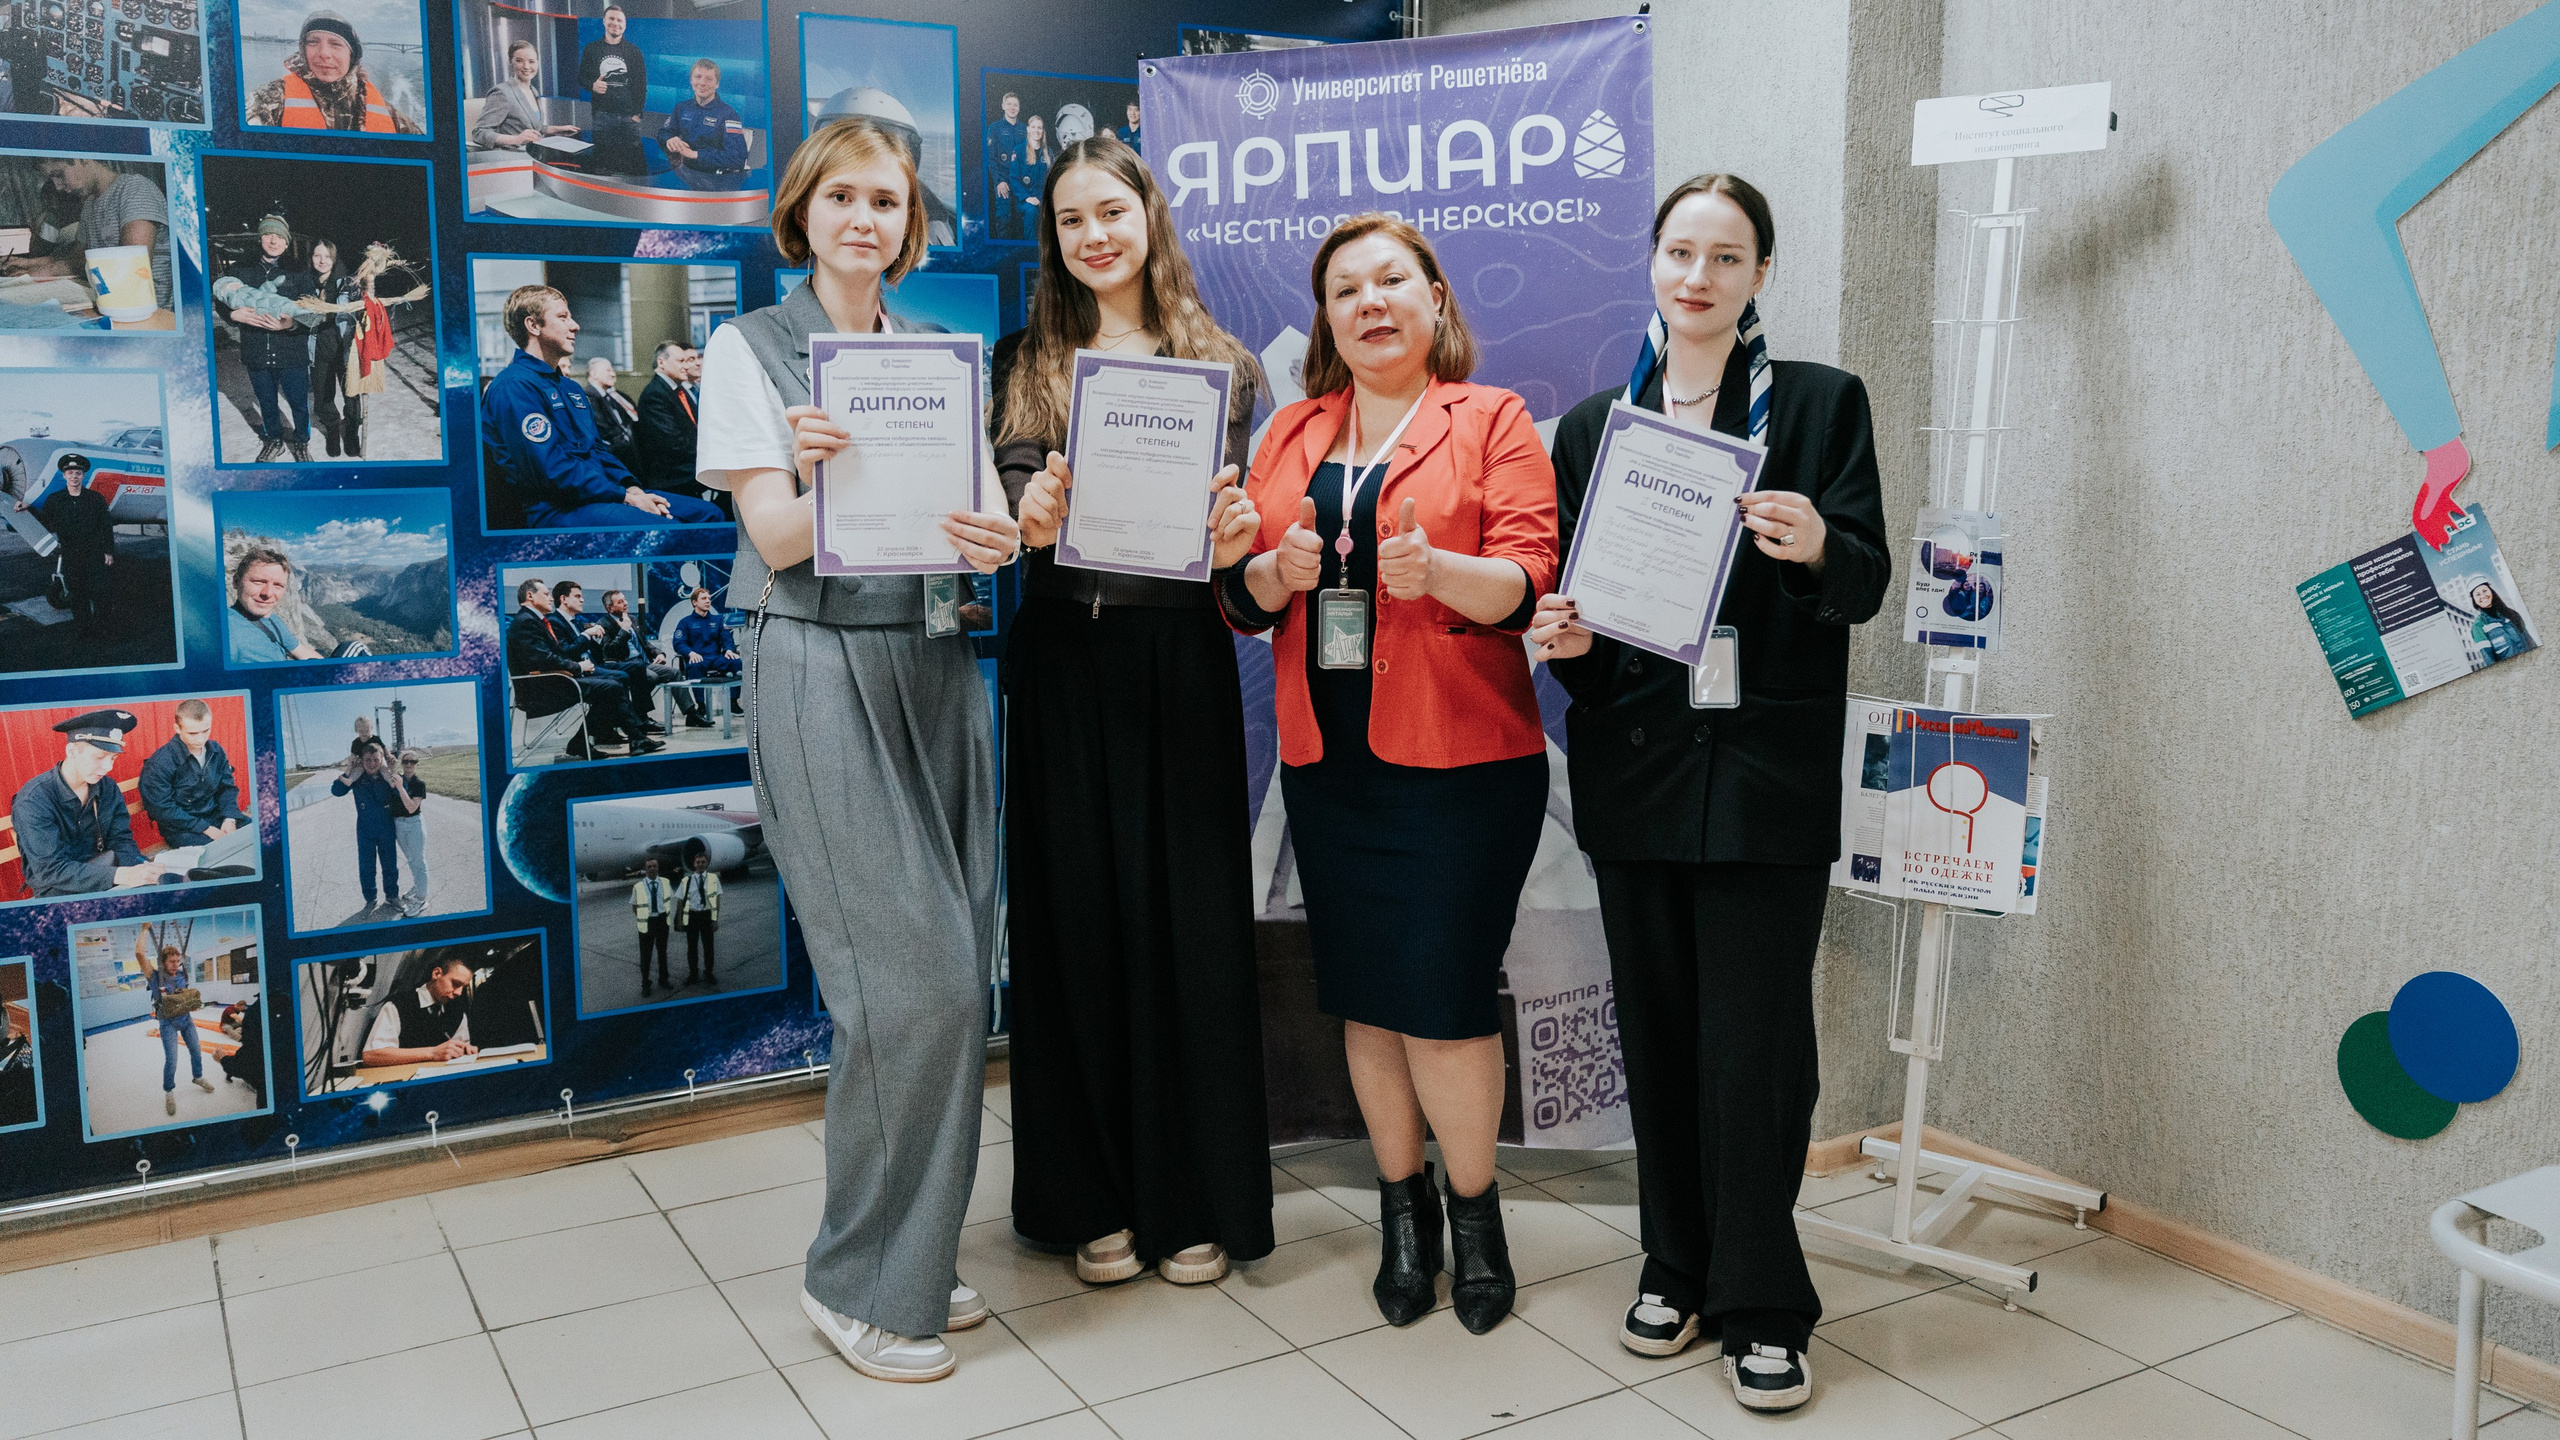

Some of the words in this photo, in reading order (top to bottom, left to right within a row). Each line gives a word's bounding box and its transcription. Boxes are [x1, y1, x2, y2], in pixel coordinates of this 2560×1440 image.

[1291, 73, 1424, 106] Университет
[1430, 57, 1547, 90] Решетнёва
[1954, 130, 2000, 141] Институт
[2001, 124, 2064, 137] социального
[1974, 141, 2040, 153] инжиниринга
[1167, 114, 1566, 208] ЯРПИАР
[1361, 198, 1602, 232] -НЕРСКОЕ!»
[849, 396, 946, 413] ДИПЛОМ
[885, 420, 934, 429] СТЕПЕНИ
[1104, 411, 1194, 432] ДИПЛОМ
[1136, 436, 1181, 448] СТЕПЕНИ
[131, 464, 150, 472] УВАУ
[1624, 469, 1713, 509] ДИПЛОМ
[1651, 502, 1695, 522] СТЕПЕНИ
[2446, 542, 2470, 556] СТАНЬ
[2353, 560, 2373, 572] Наша
[2373, 547, 2403, 564] команда
[2356, 550, 2414, 578] профессионалов
[2378, 565, 2396, 577] тебя!
[2323, 580, 2344, 593] новым
[1904, 850, 1995, 870] ВСТРЕЧАЕМ
[1902, 862, 1923, 874] ПО
[1930, 866, 1994, 884] ОДЕЖКЕ
[1522, 984, 1600, 1014] ГРУППА
